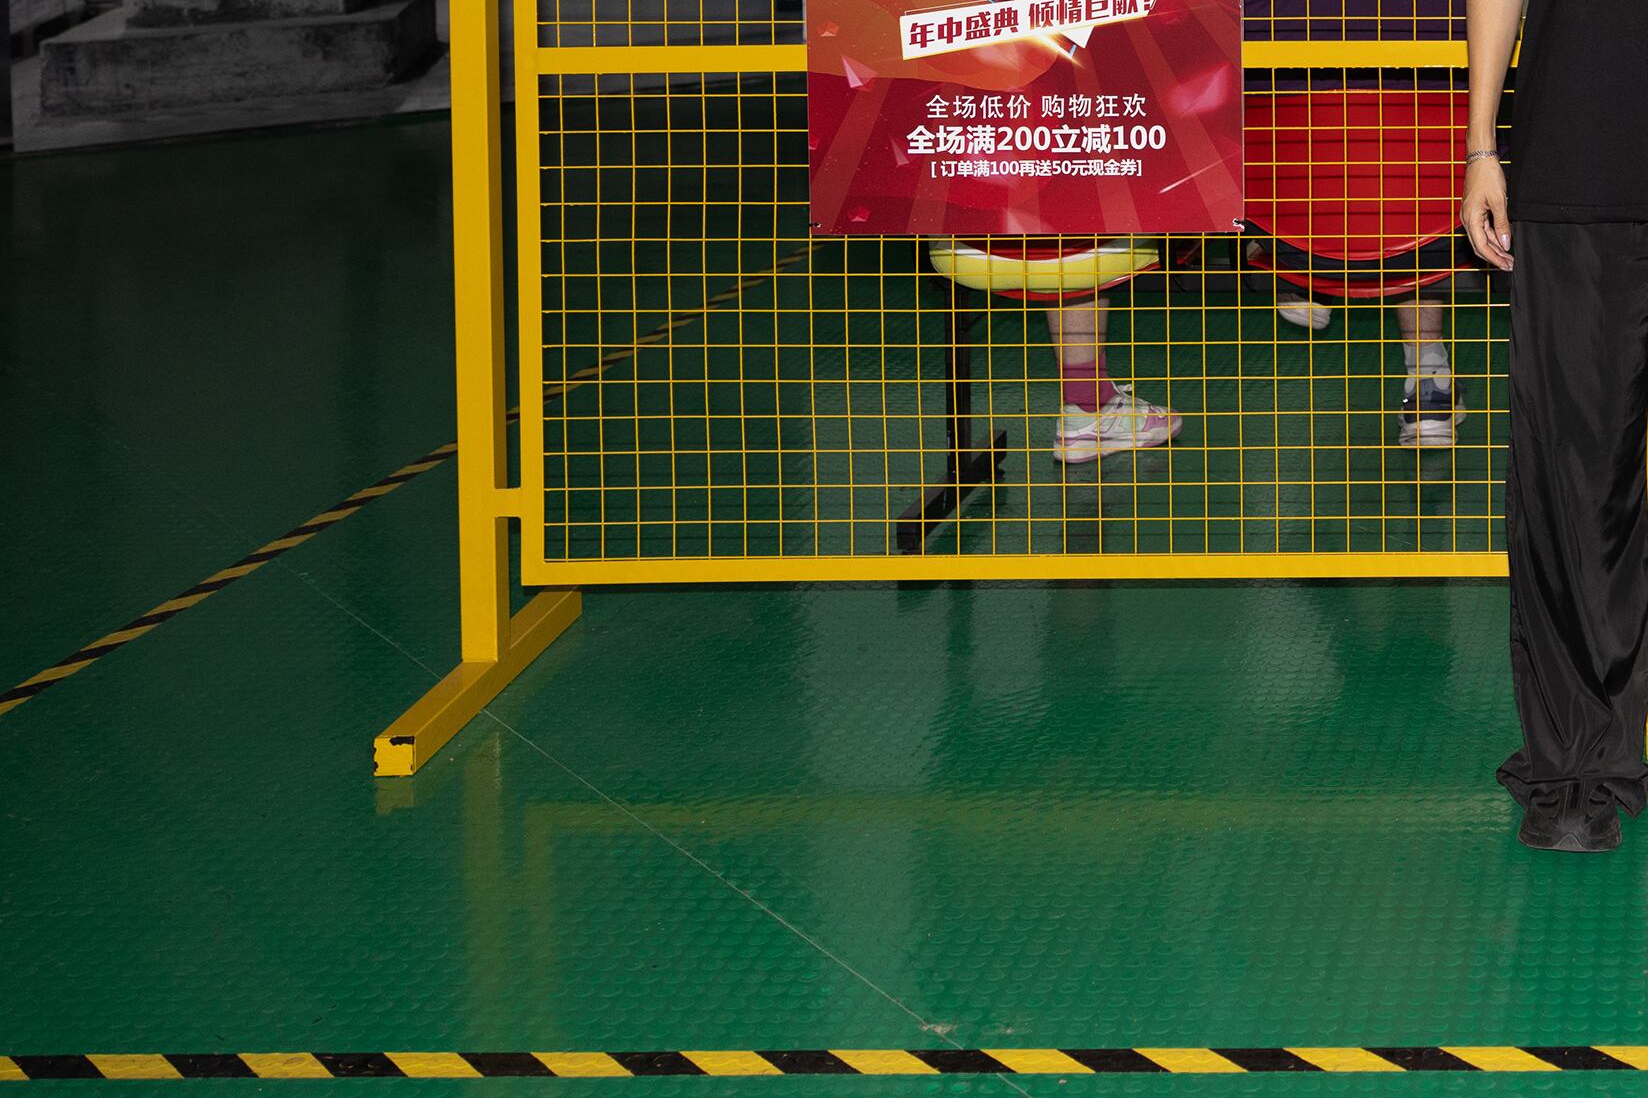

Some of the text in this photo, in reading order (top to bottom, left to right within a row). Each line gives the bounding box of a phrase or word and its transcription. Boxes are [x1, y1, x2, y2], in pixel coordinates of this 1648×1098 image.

[908, 7, 1019, 49] 年中盛典
[926, 93, 1147, 119] 全场低价 购物狂欢
[906, 124, 1167, 155] 全场满200立减100
